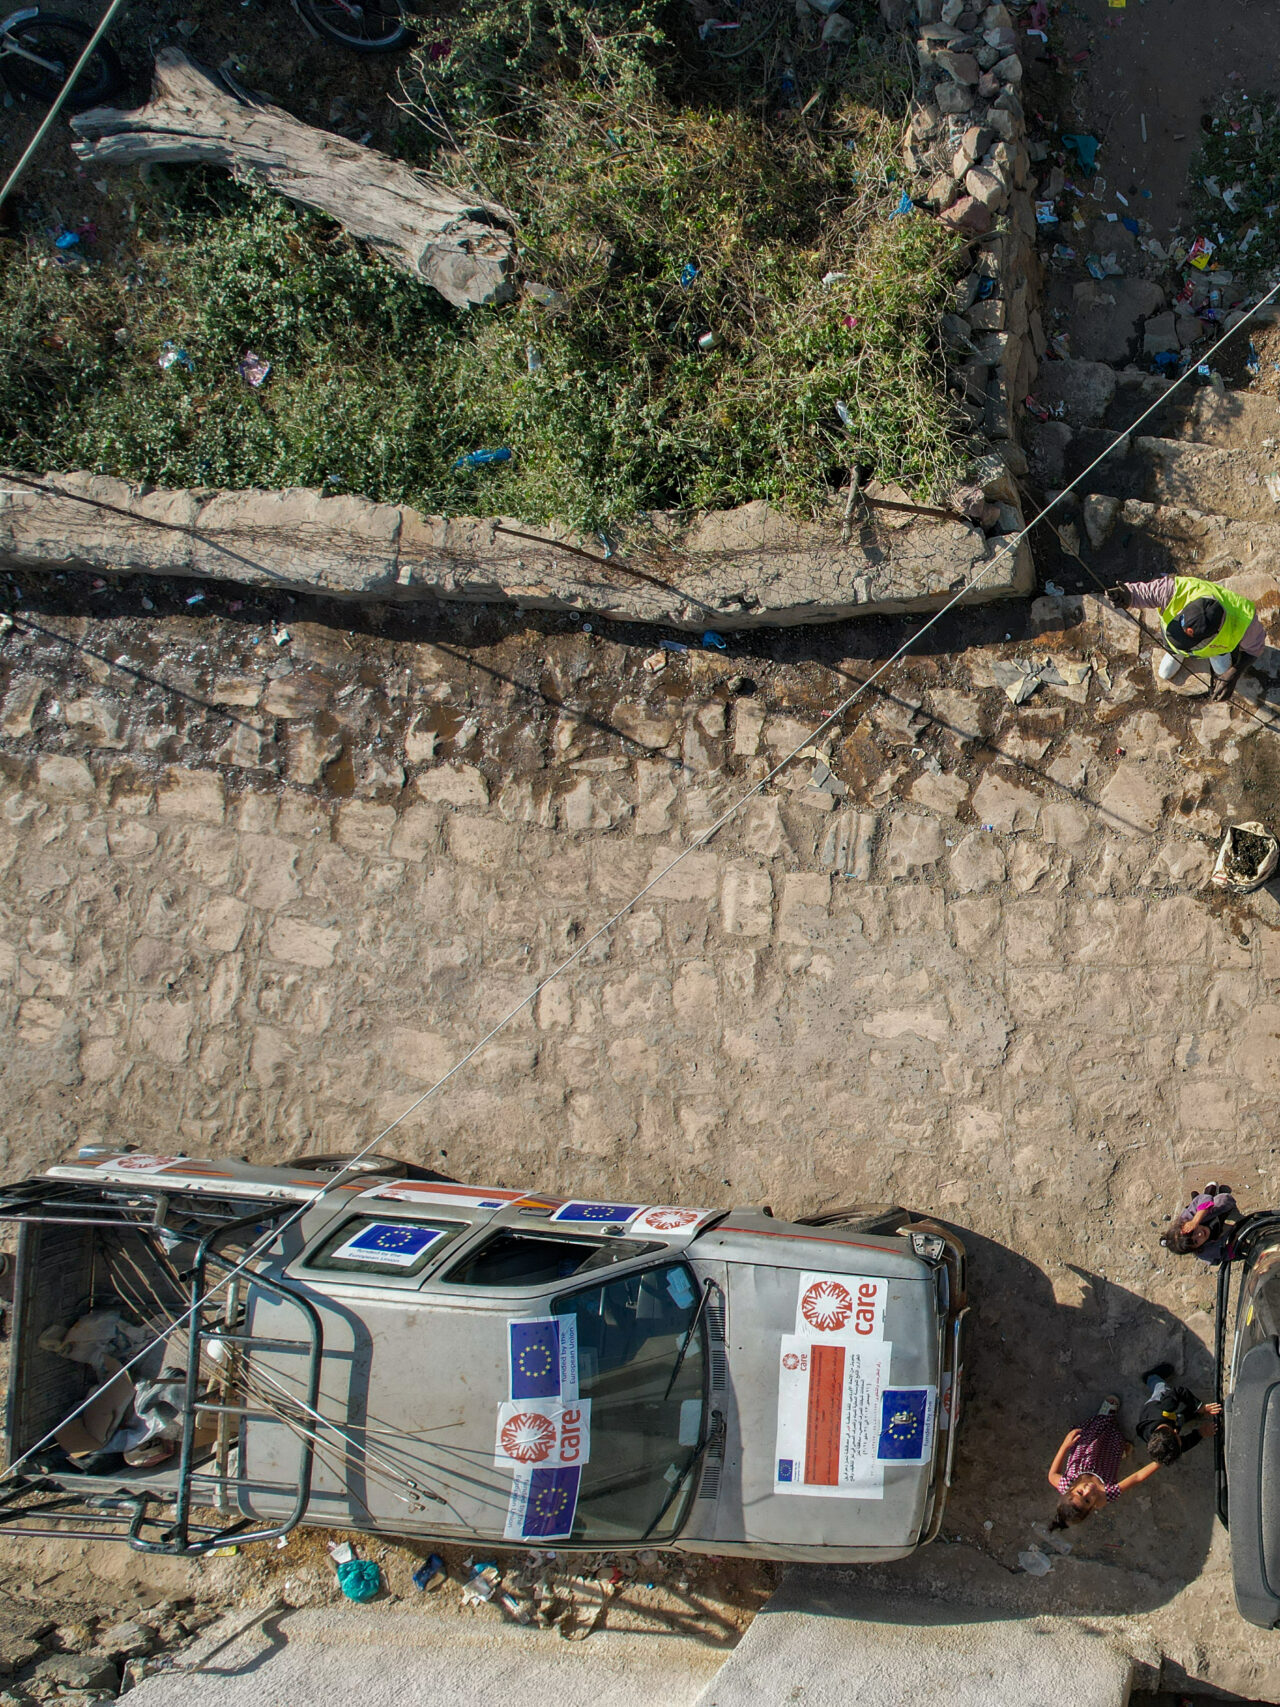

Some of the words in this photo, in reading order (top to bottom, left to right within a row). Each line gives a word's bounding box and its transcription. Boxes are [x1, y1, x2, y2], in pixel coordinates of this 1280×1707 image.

[855, 1283, 878, 1336] care
[561, 1346, 567, 1355] by
[800, 1353, 808, 1372] care
[559, 1409, 581, 1463] care
